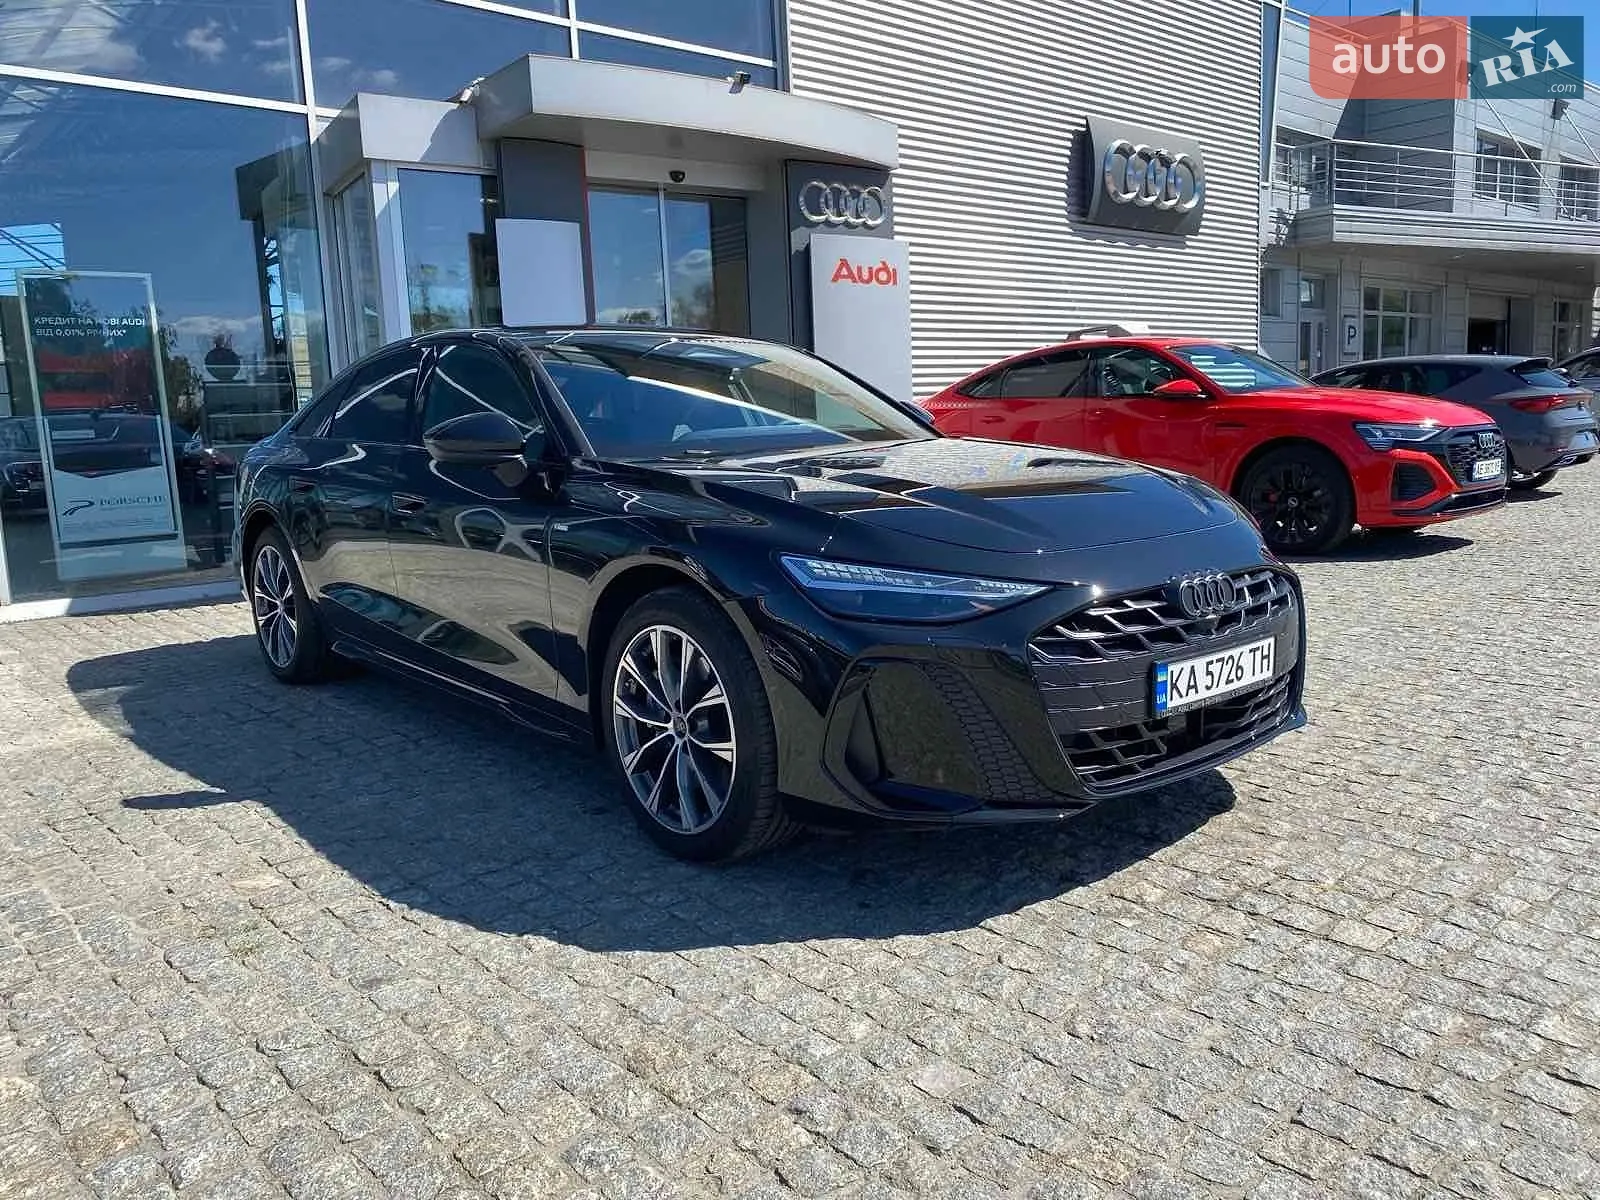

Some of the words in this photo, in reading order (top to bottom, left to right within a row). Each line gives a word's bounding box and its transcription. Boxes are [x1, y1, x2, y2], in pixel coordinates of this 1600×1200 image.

[831, 258, 897, 286] Audi
[33, 316, 76, 326] КРЕДИТ
[79, 317, 93, 325] НА
[122, 317, 145, 327] AUDI
[35, 328, 53, 337] ВІД
[1347, 325, 1357, 345] P
[1170, 665, 1199, 702] KA
[1205, 651, 1244, 691] 5726
[1249, 643, 1271, 677] TH
[1156, 693, 1167, 704] UA
